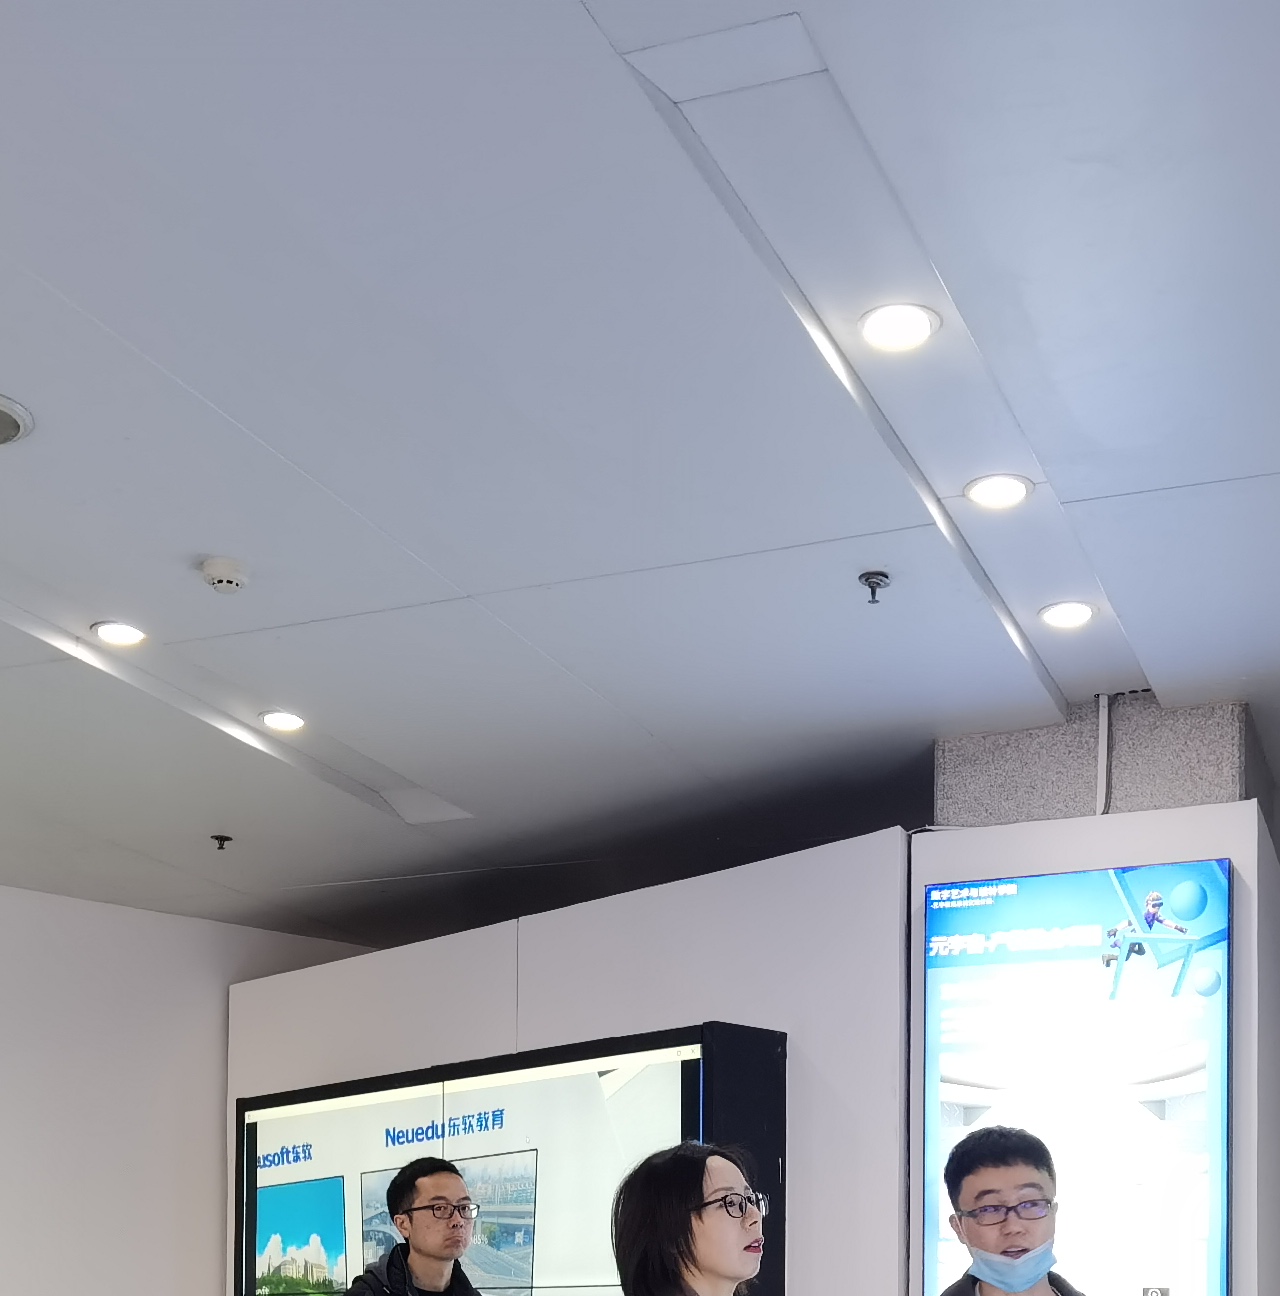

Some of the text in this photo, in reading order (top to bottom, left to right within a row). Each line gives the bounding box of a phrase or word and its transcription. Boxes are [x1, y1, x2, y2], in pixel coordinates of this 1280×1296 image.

[385, 1108, 506, 1148] Neuedu 东软教育
